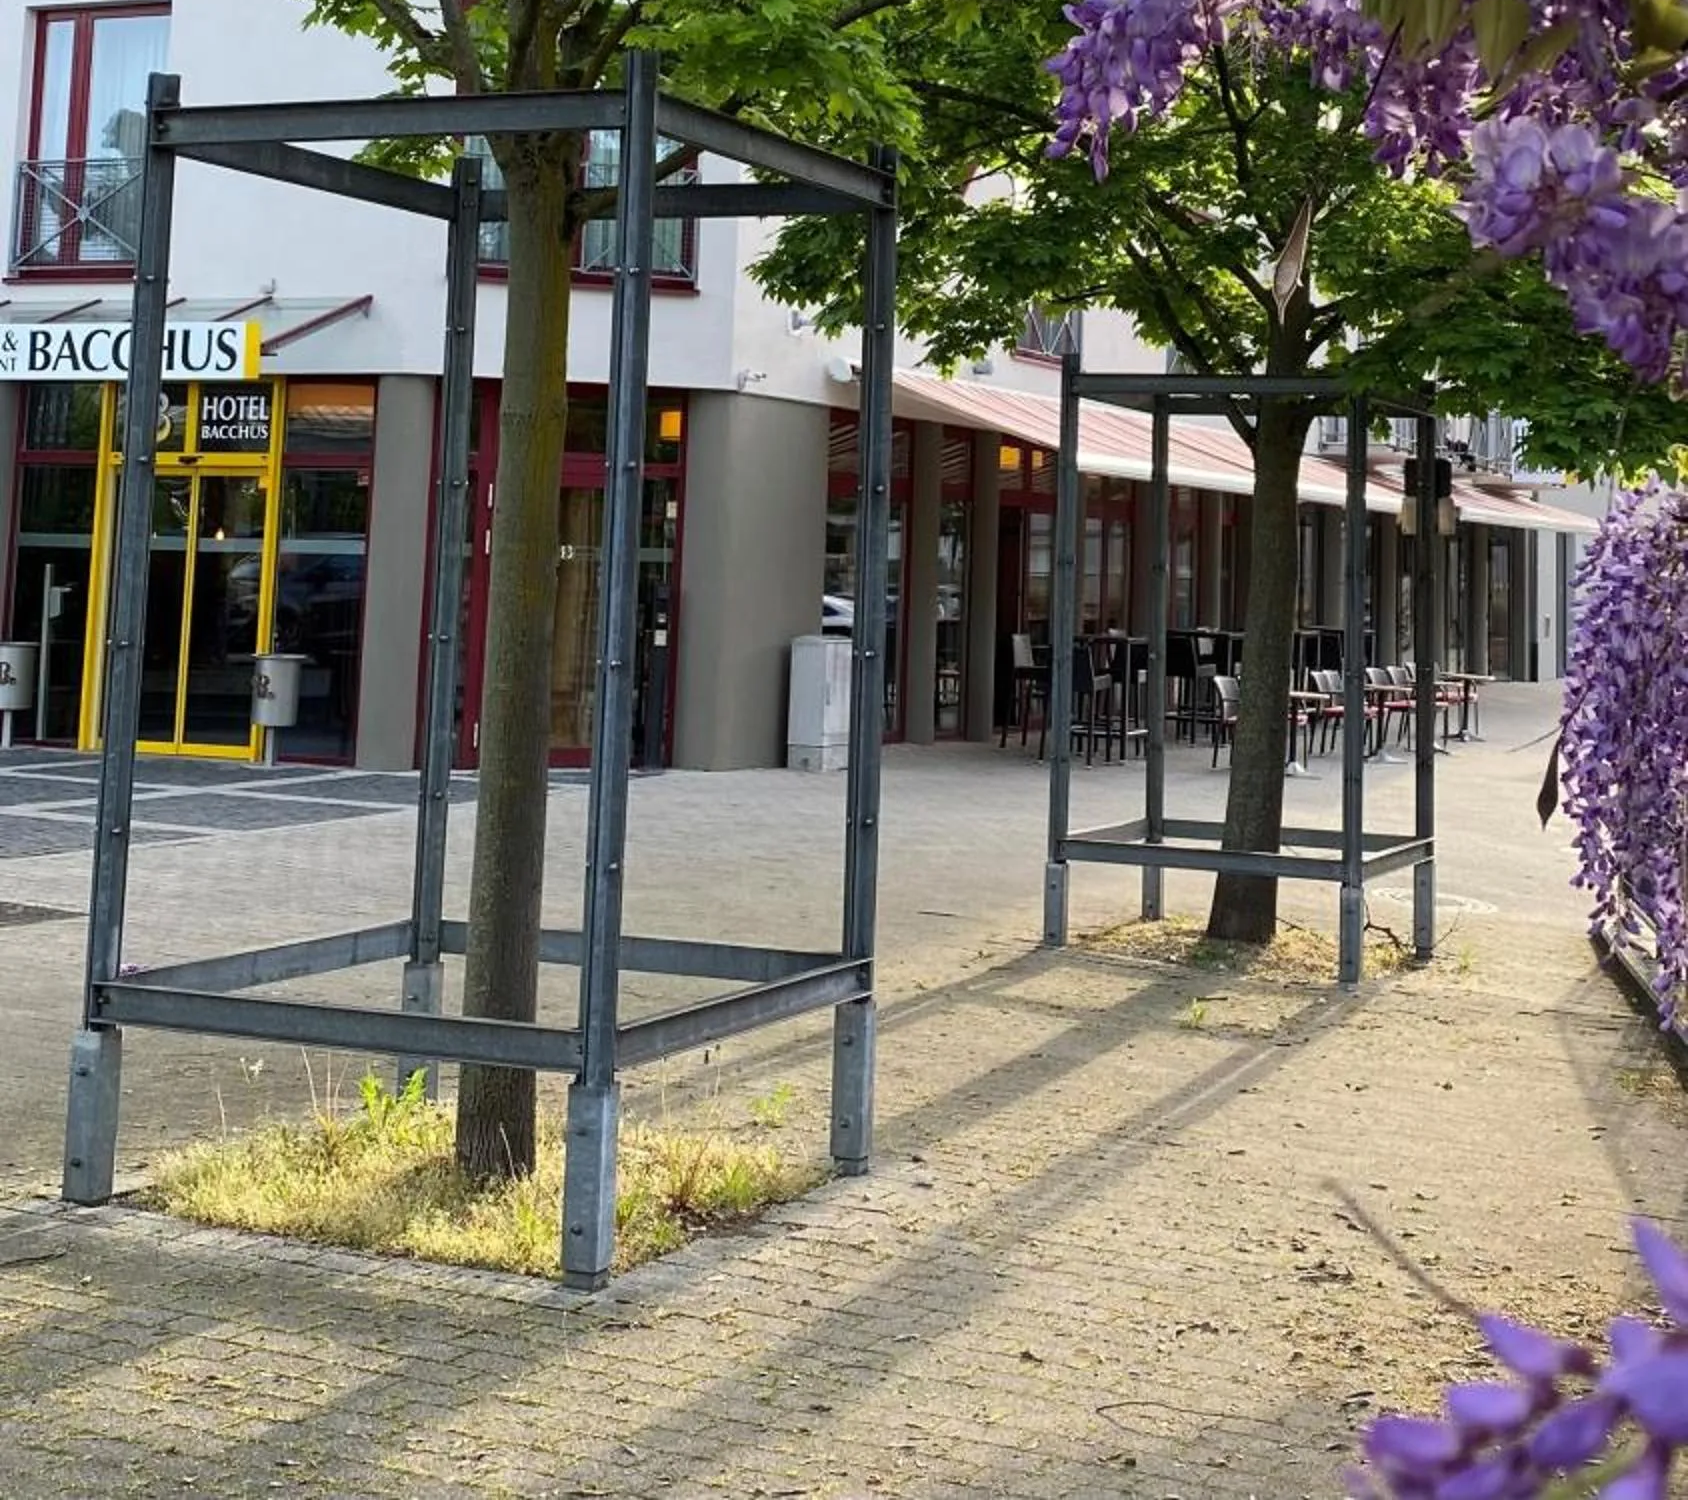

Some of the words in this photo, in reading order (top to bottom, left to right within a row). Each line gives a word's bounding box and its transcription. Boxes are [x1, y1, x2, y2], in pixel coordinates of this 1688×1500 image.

[2, 330, 18, 351] &
[202, 395, 269, 421] HOTEL
[201, 425, 269, 439] BACCHUS
